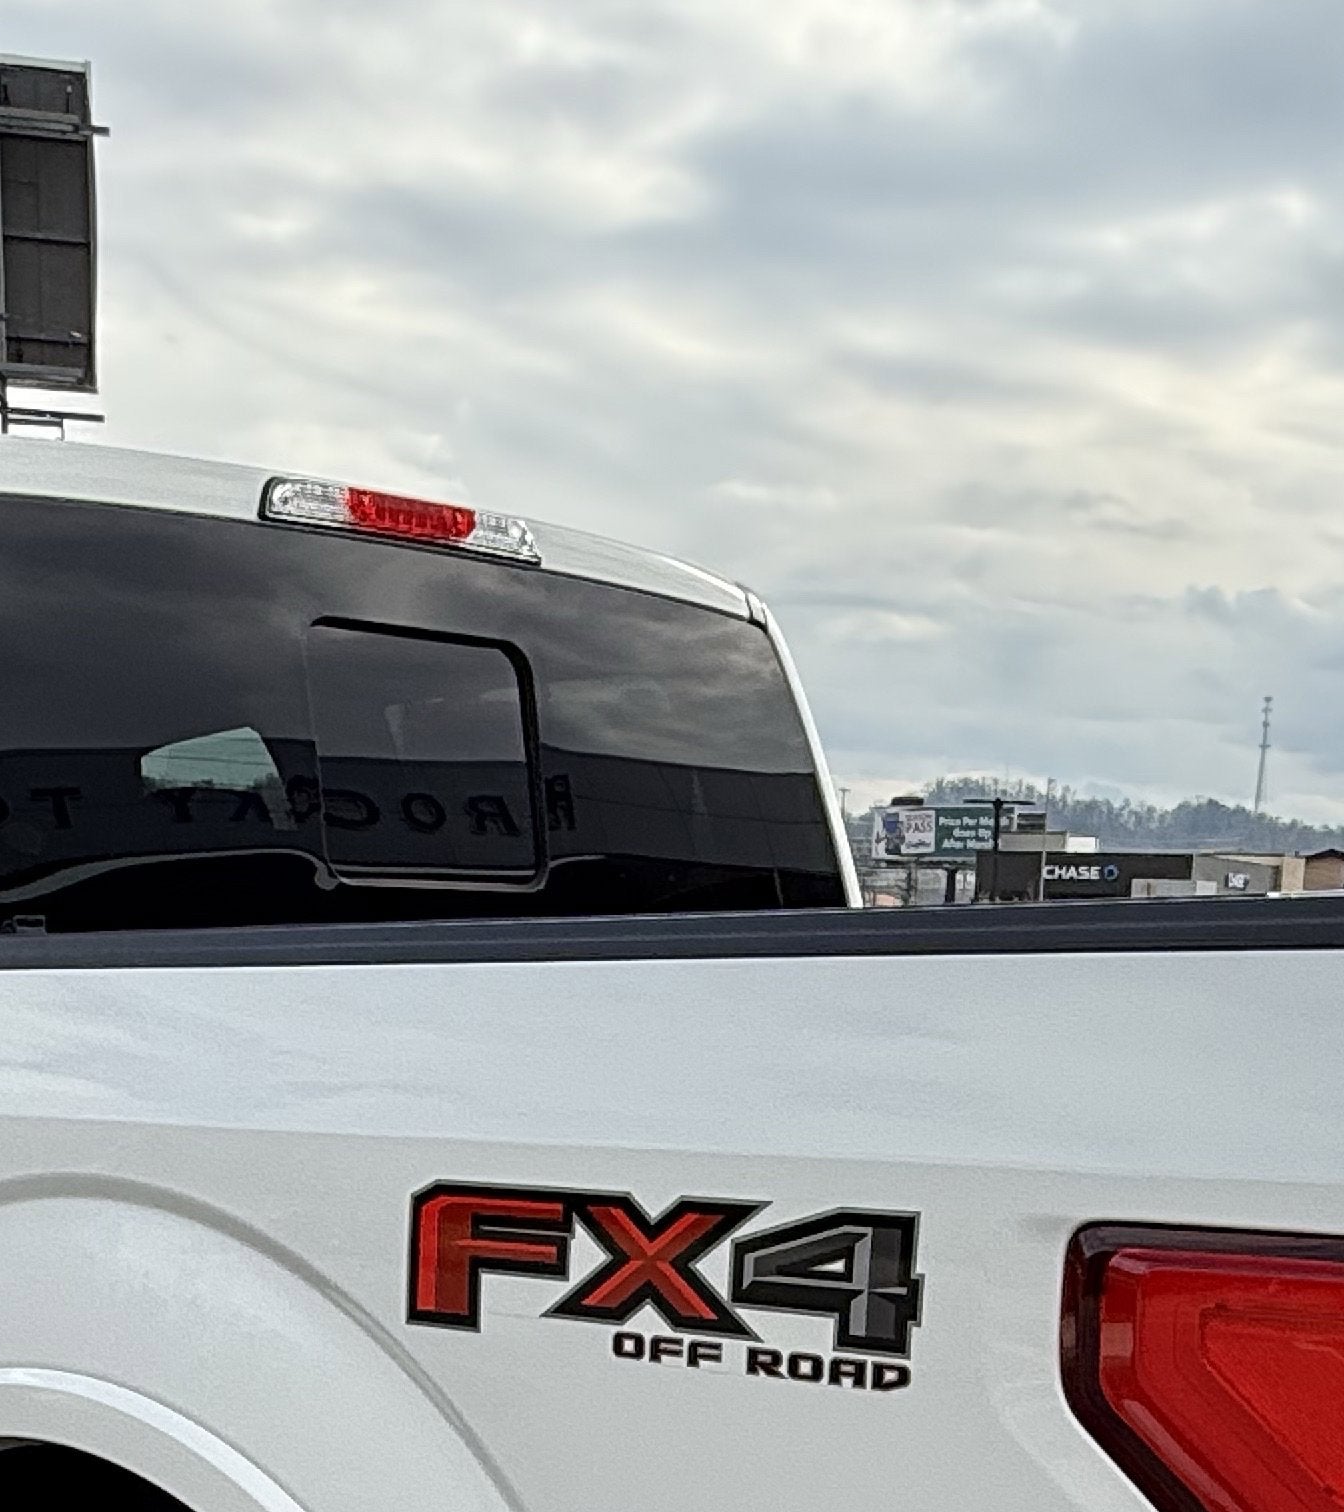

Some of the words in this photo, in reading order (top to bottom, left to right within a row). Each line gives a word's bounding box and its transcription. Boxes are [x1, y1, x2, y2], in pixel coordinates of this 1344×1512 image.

[1042, 865, 1102, 880] CHASE
[406, 1179, 924, 1360] FX4
[612, 1331, 723, 1369] OFF
[746, 1346, 912, 1392] ROAD
